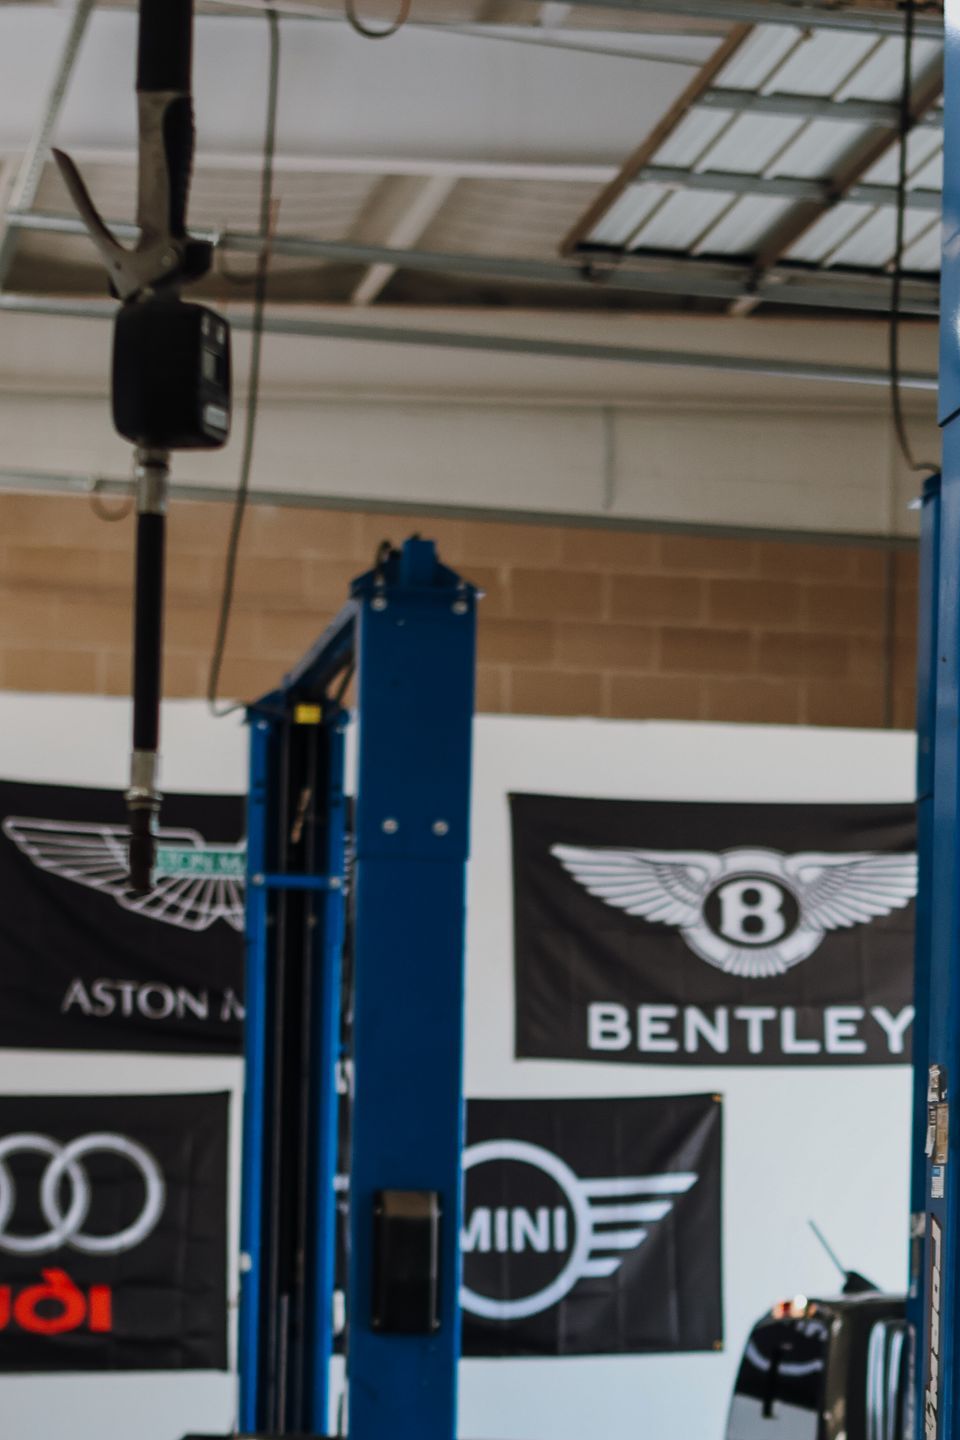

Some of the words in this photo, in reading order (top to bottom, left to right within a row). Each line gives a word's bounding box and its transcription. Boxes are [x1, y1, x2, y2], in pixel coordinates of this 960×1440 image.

[718, 880, 786, 944] B
[61, 978, 208, 1020] ASTON
[587, 1002, 916, 1054] BENTLEY
[459, 1206, 567, 1253] MINI
